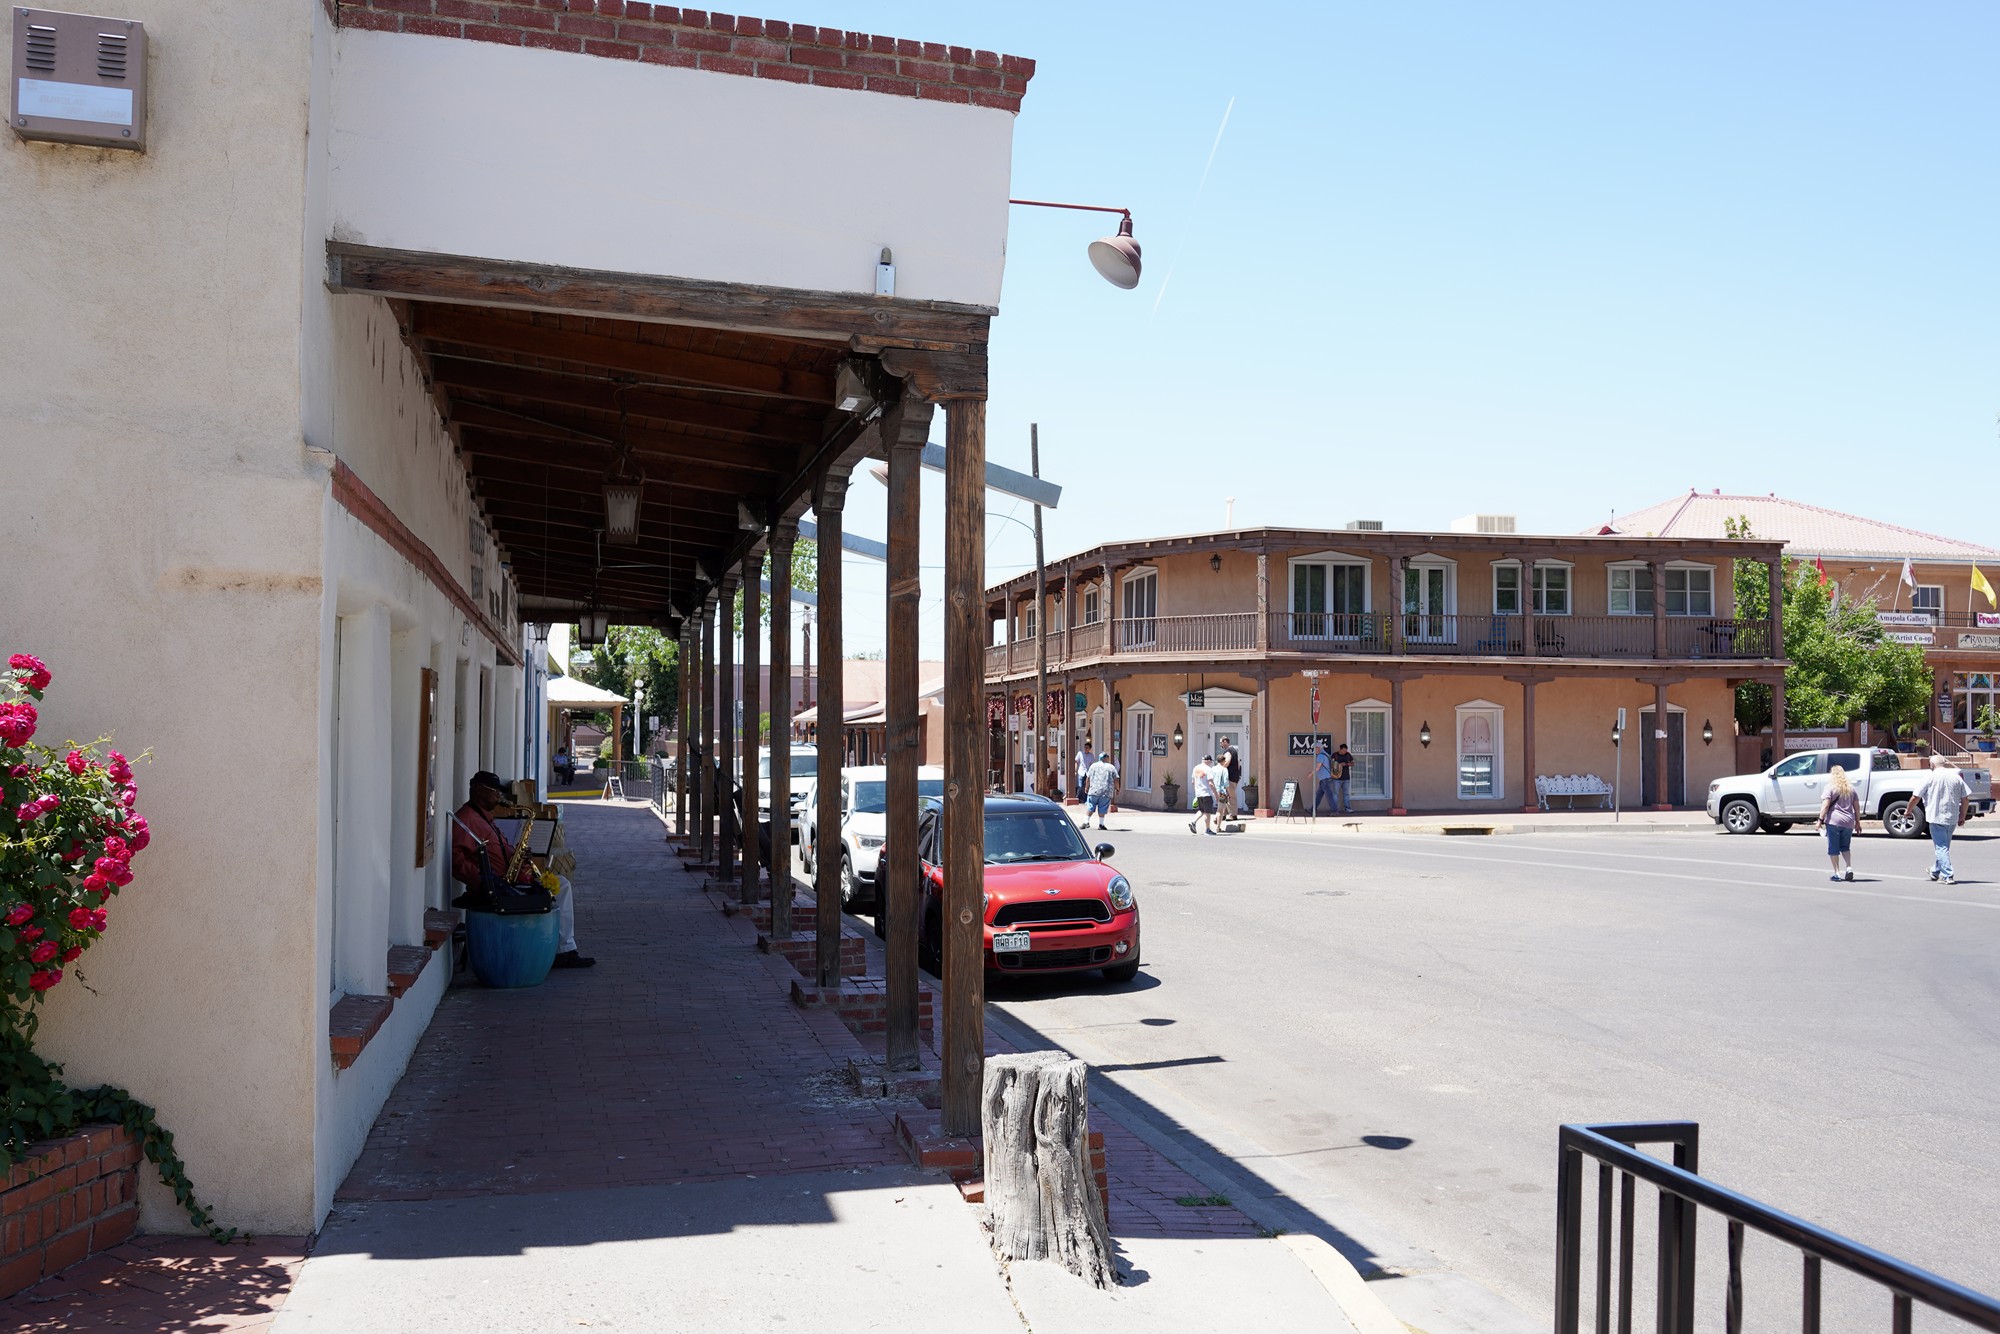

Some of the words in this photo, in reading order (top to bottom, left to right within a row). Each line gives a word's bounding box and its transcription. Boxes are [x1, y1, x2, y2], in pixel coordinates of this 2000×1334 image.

[1906, 615, 1928, 623] Gallery
[1914, 634, 1932, 643] Co-op
[1970, 635, 1995, 644] RAVEN
